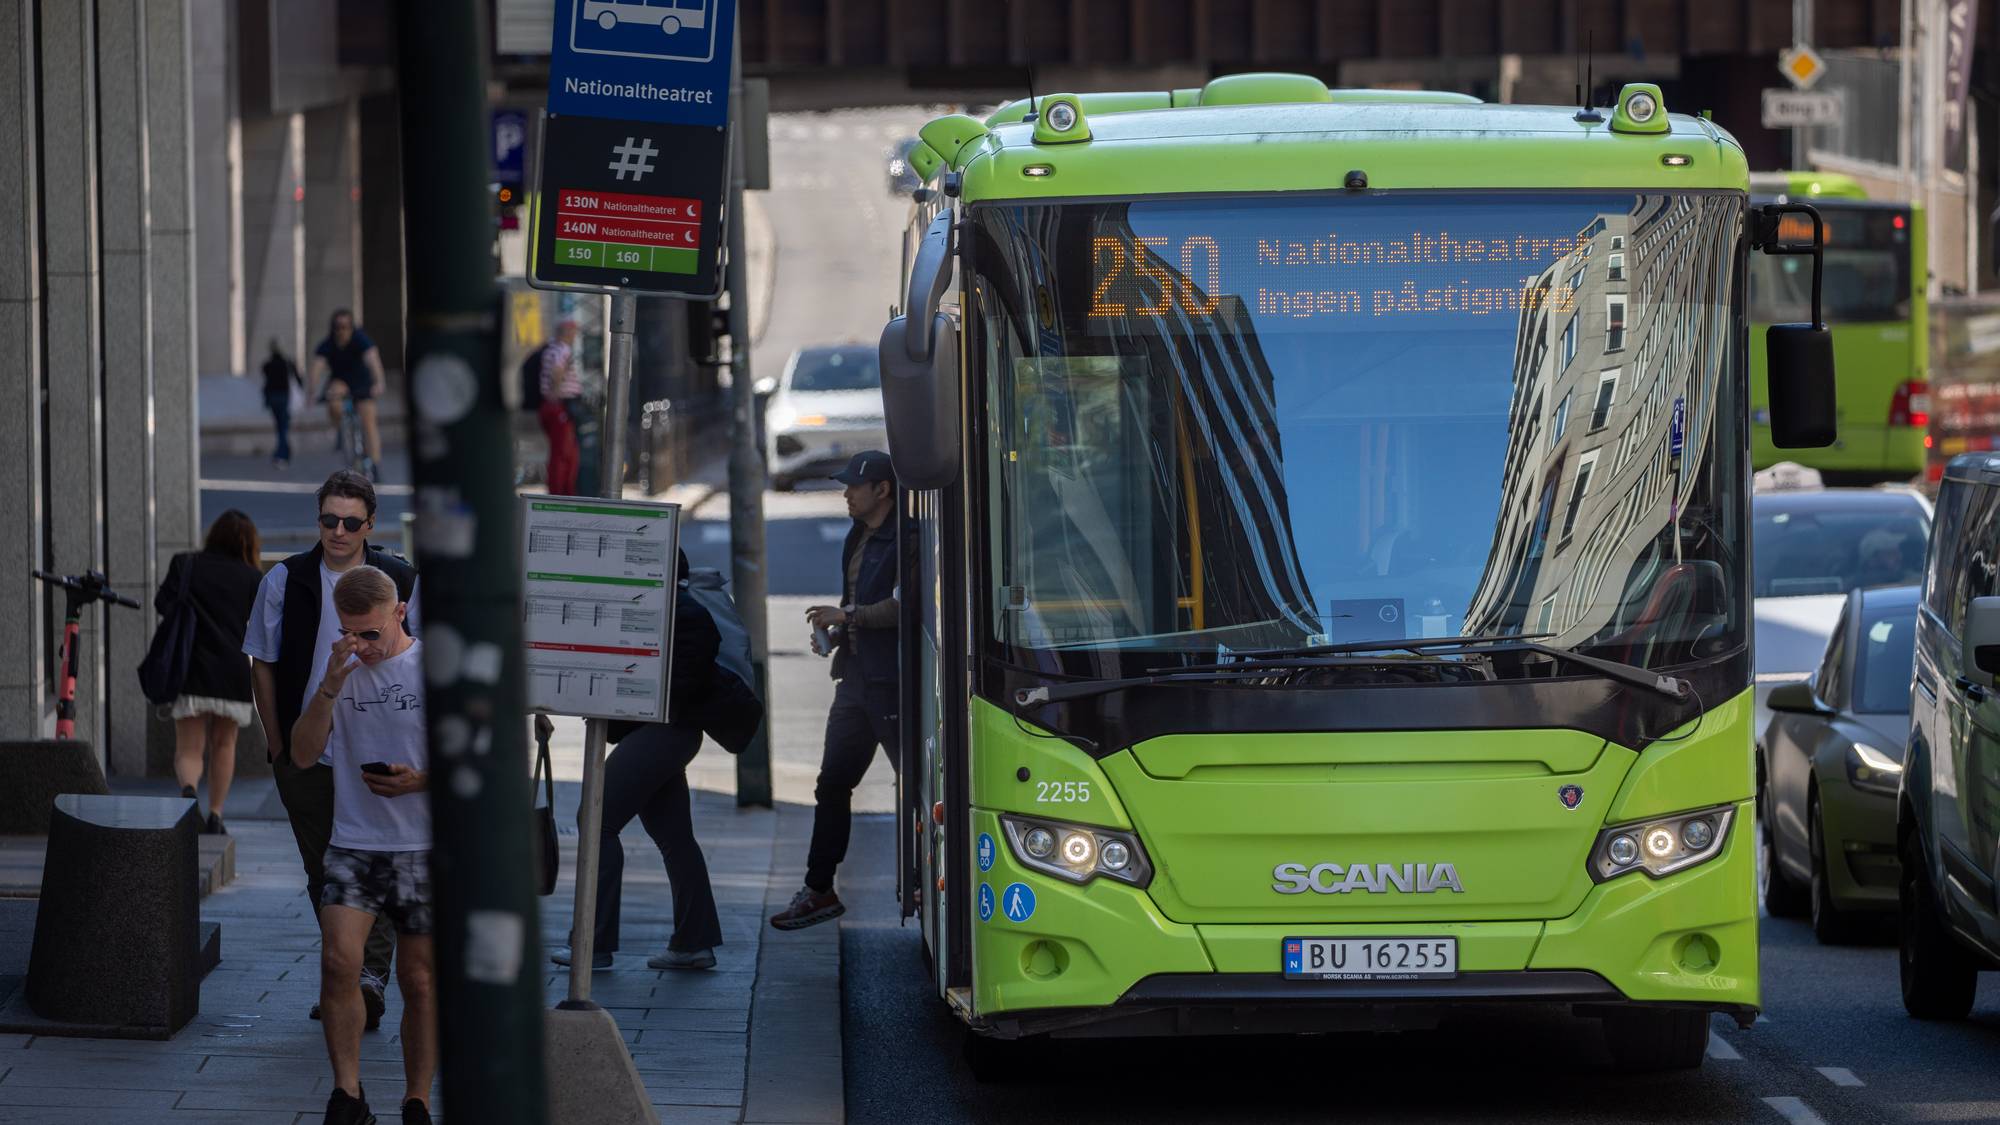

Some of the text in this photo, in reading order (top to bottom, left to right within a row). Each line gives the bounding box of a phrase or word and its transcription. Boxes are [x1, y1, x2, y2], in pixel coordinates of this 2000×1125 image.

[564, 77, 713, 104] Nationaltheatret
[496, 122, 522, 162] P
[565, 196, 676, 215] 130N Nationaltheatret
[563, 222, 674, 241] 140N Nationaltheatret
[567, 247, 592, 260] 150
[615, 251, 640, 264] 160
[1258, 231, 1591, 265] Nationaltheatret
[1088, 235, 1221, 318] 250
[1258, 279, 1575, 317] Ingen påstigning
[1036, 781, 1091, 803] 2255
[1272, 862, 1464, 895] SCANIA
[1310, 943, 1448, 969] BU 16255
